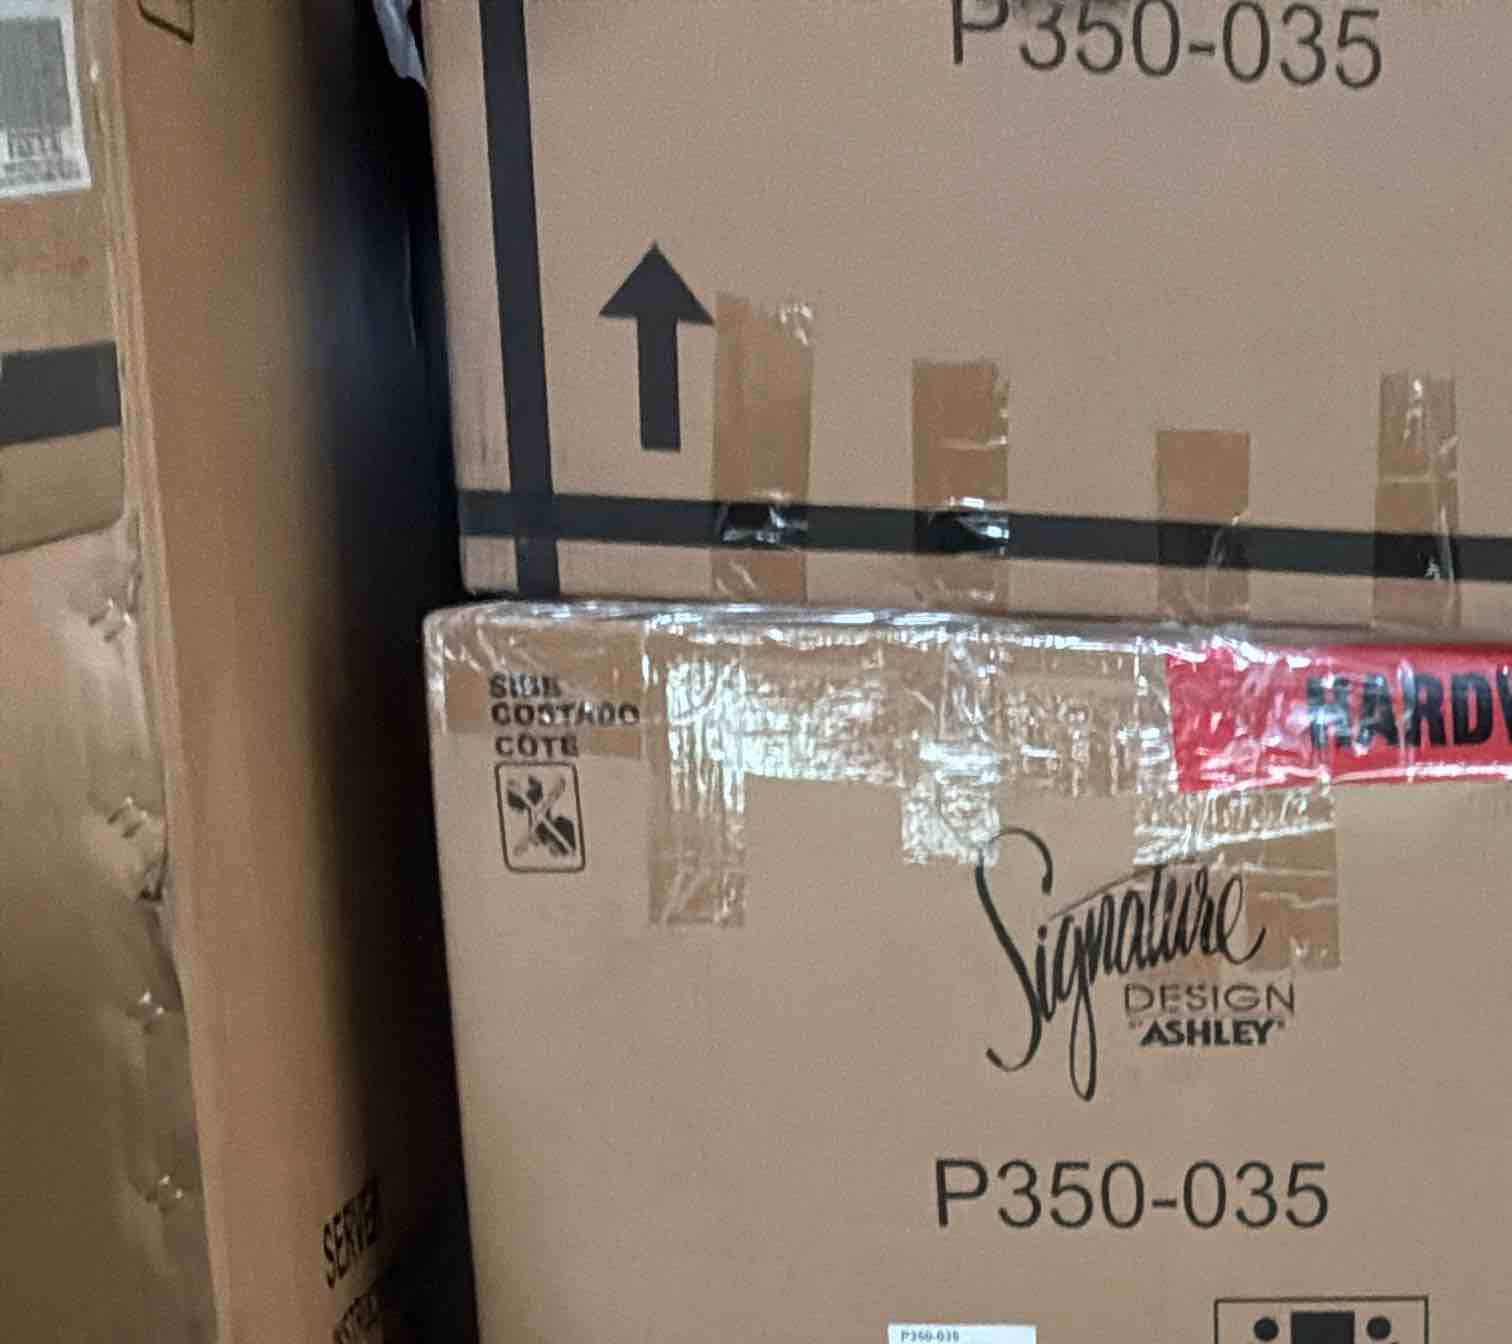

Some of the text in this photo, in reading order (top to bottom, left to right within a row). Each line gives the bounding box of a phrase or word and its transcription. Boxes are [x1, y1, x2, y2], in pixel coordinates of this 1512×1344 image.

[951, 0, 1384, 88] P350-035
[975, 827, 1266, 1102] Signature
[1124, 982, 1295, 1016] DESIGN
[1140, 1020, 1275, 1046] ASHLEY
[933, 1158, 1329, 1229] P350-035
